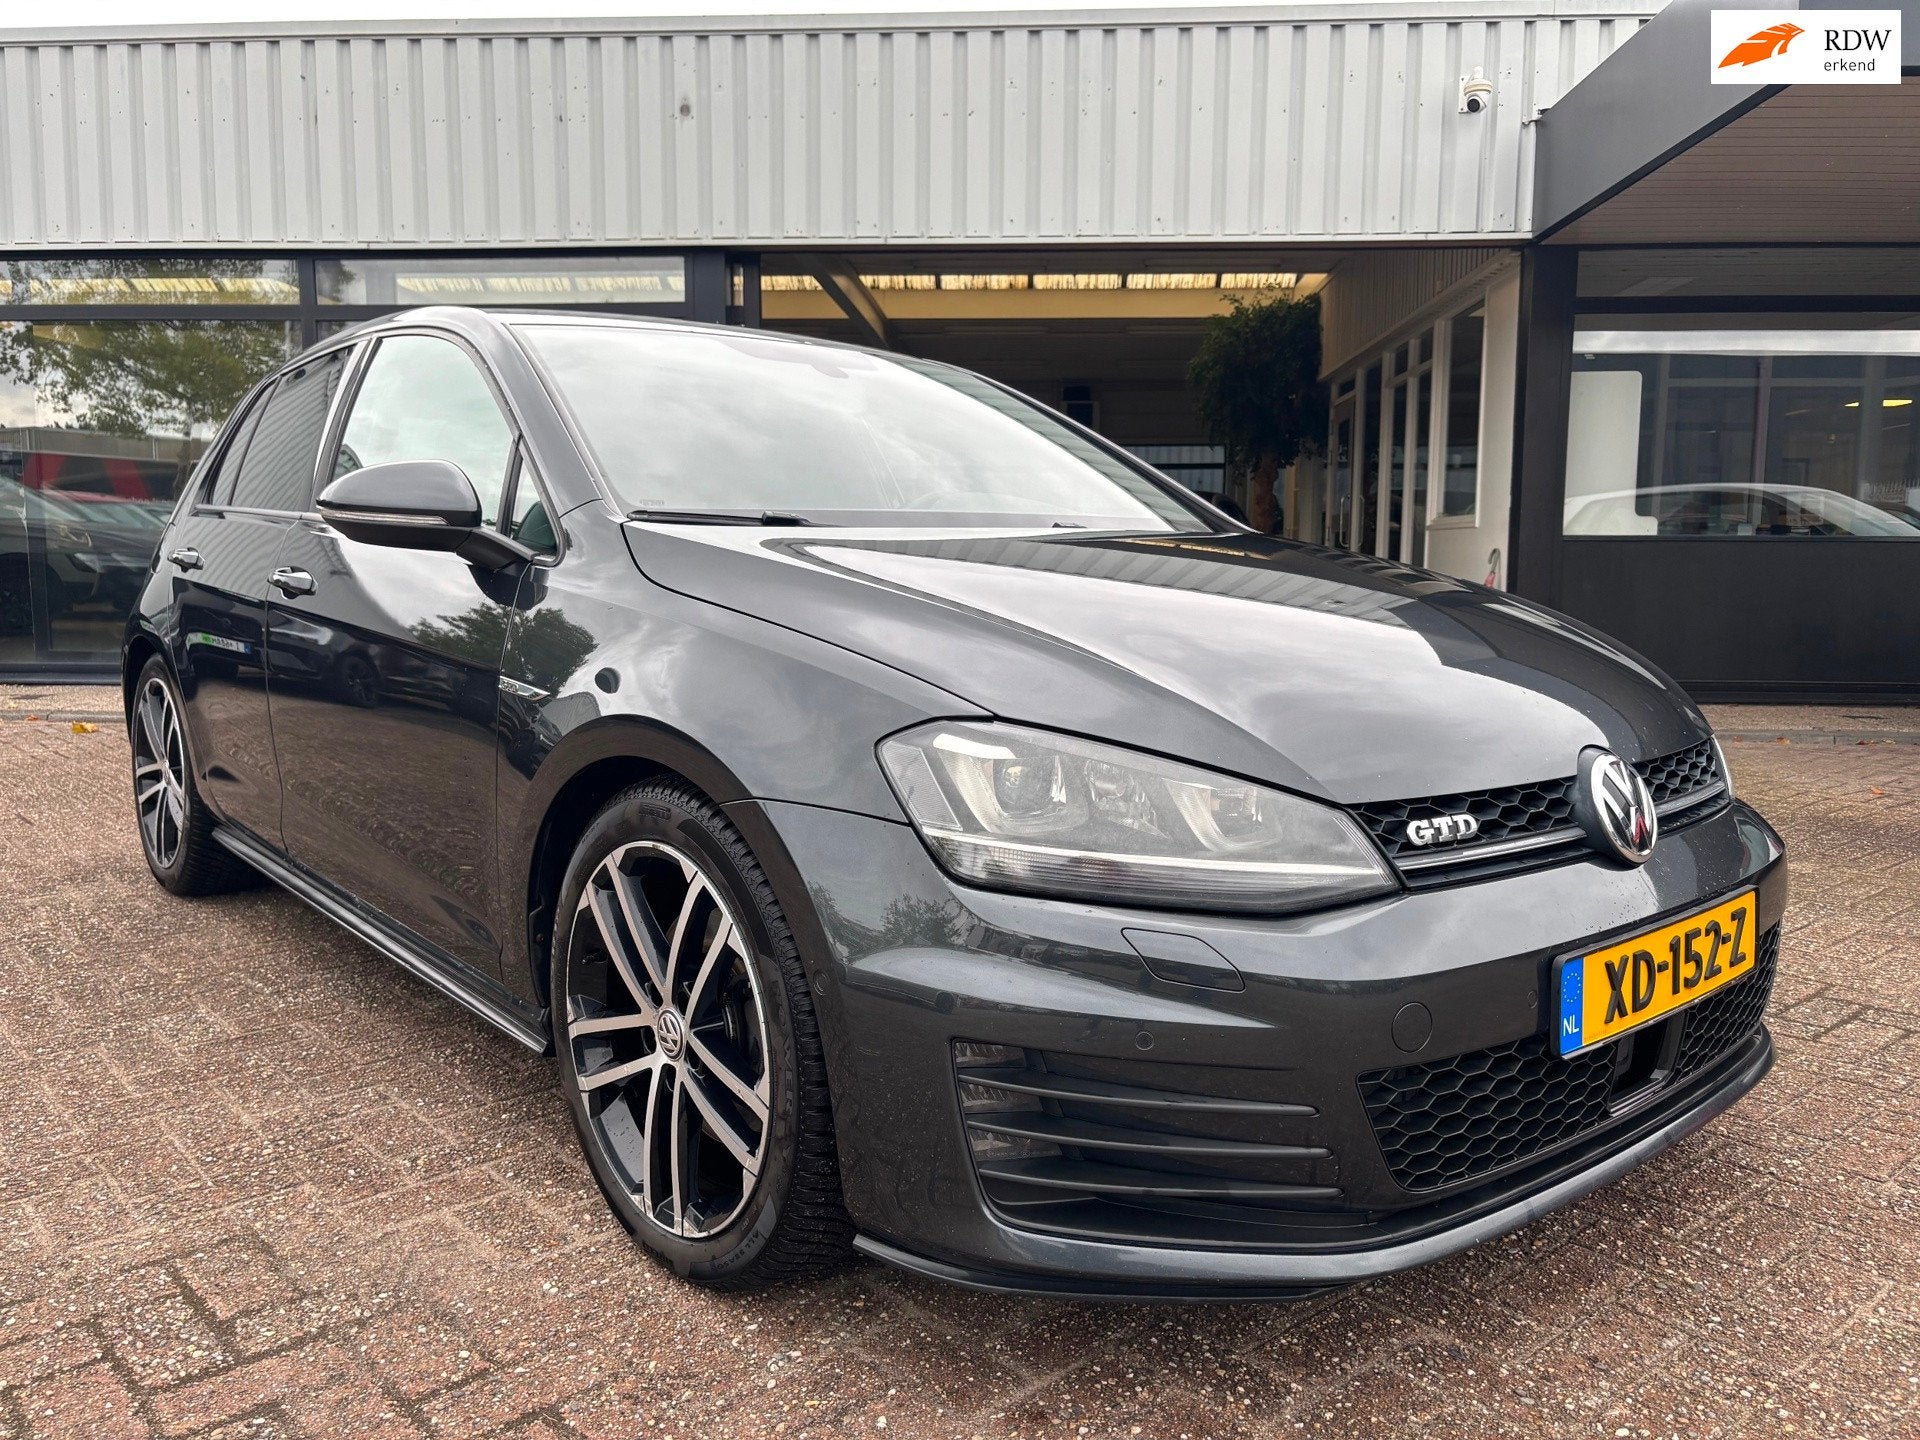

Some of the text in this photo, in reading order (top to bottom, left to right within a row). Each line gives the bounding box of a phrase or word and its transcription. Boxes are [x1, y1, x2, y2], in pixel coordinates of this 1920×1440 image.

[1406, 814, 1478, 847] GTD
[1604, 907, 1747, 1024] XD-152-Z
[1562, 1014, 1580, 1037] NL
